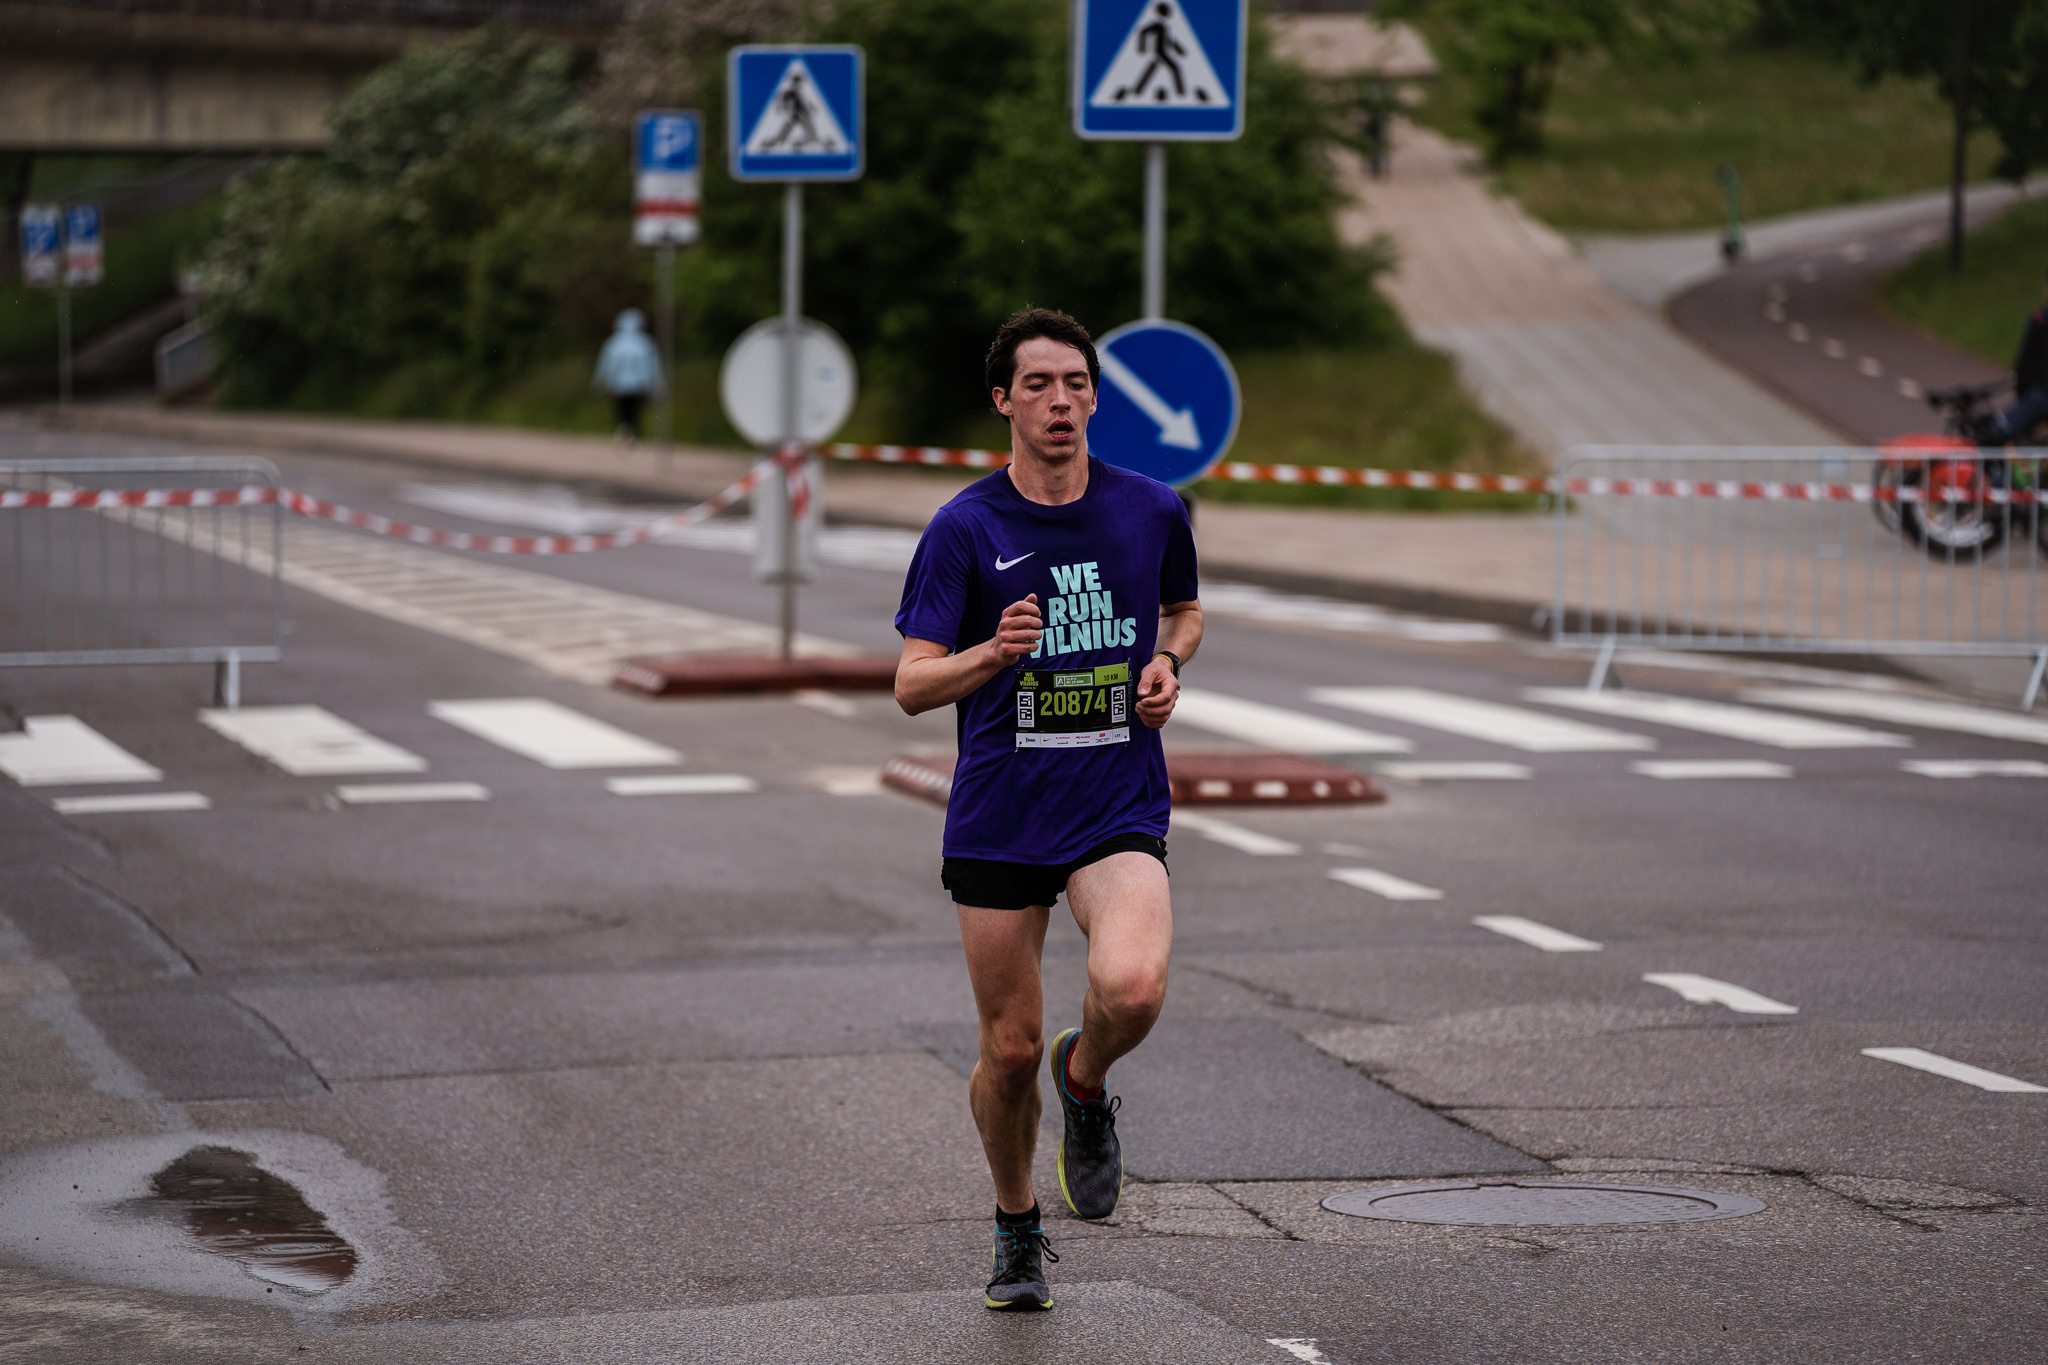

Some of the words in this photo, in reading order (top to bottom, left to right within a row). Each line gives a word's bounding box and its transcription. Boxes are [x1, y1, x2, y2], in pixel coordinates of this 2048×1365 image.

[653, 116, 693, 165] P
[1050, 561, 1101, 595] WE
[1048, 590, 1113, 626] RUN
[1029, 617, 1137, 659] VILNIUS
[1040, 688, 1107, 716] 20874
